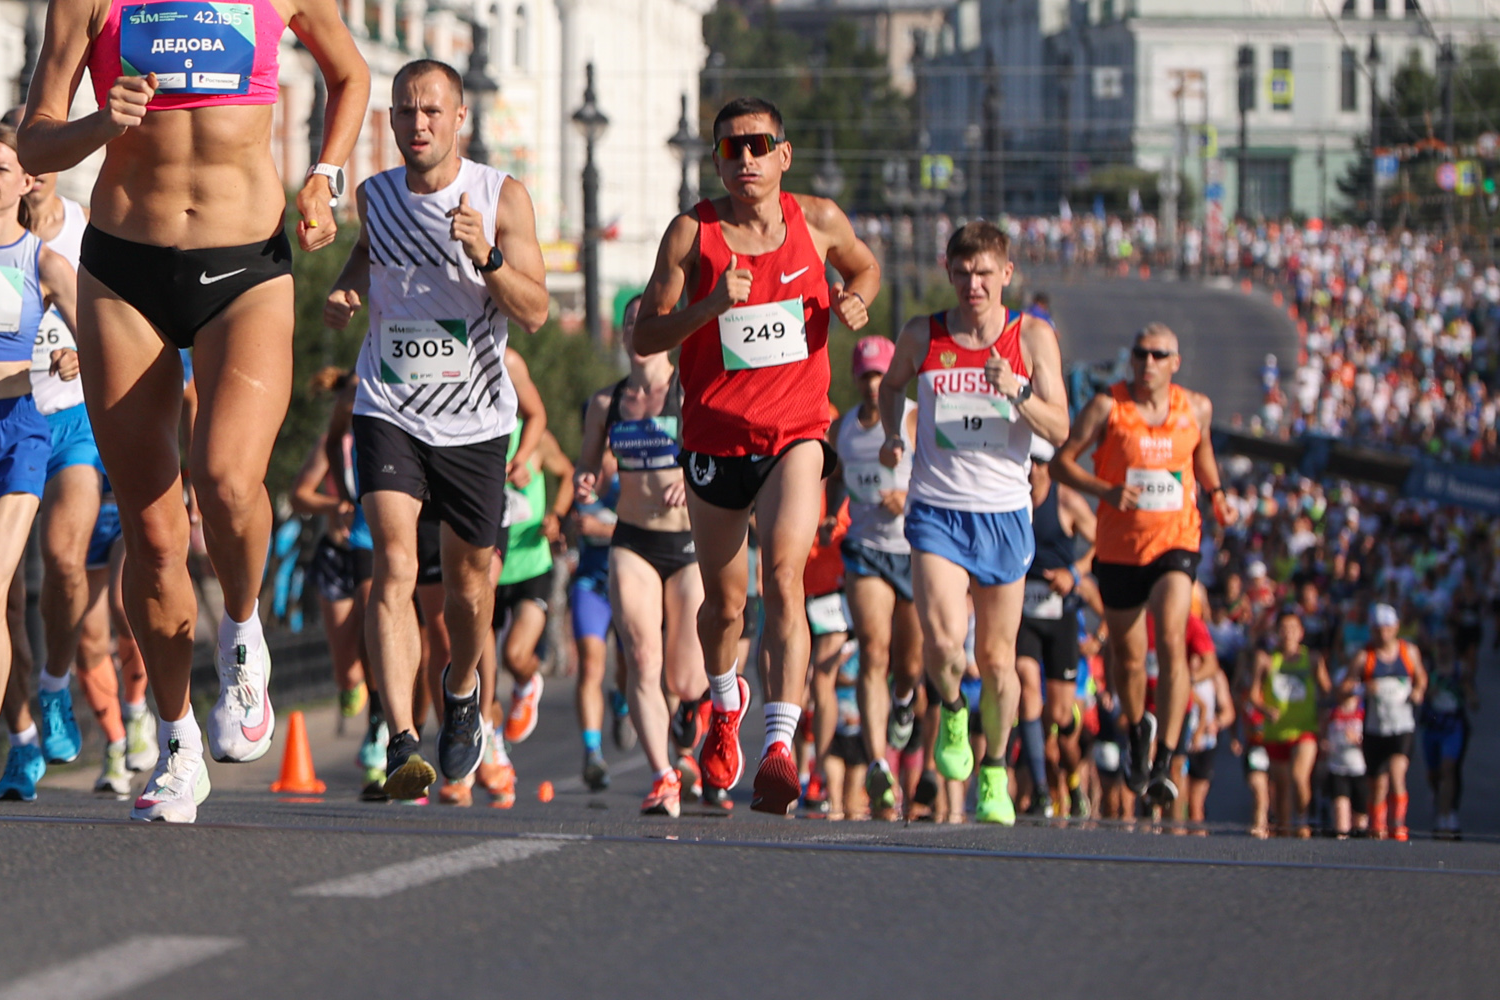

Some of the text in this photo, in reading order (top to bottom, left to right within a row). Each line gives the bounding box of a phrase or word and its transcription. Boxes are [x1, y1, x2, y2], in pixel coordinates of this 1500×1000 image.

[193, 10, 242, 26] 42.195
[151, 38, 225, 54] ДЕДОВА
[184, 58, 193, 69] 6
[742, 322, 786, 344] 249
[392, 339, 454, 358] 3005
[963, 415, 982, 431] 19
